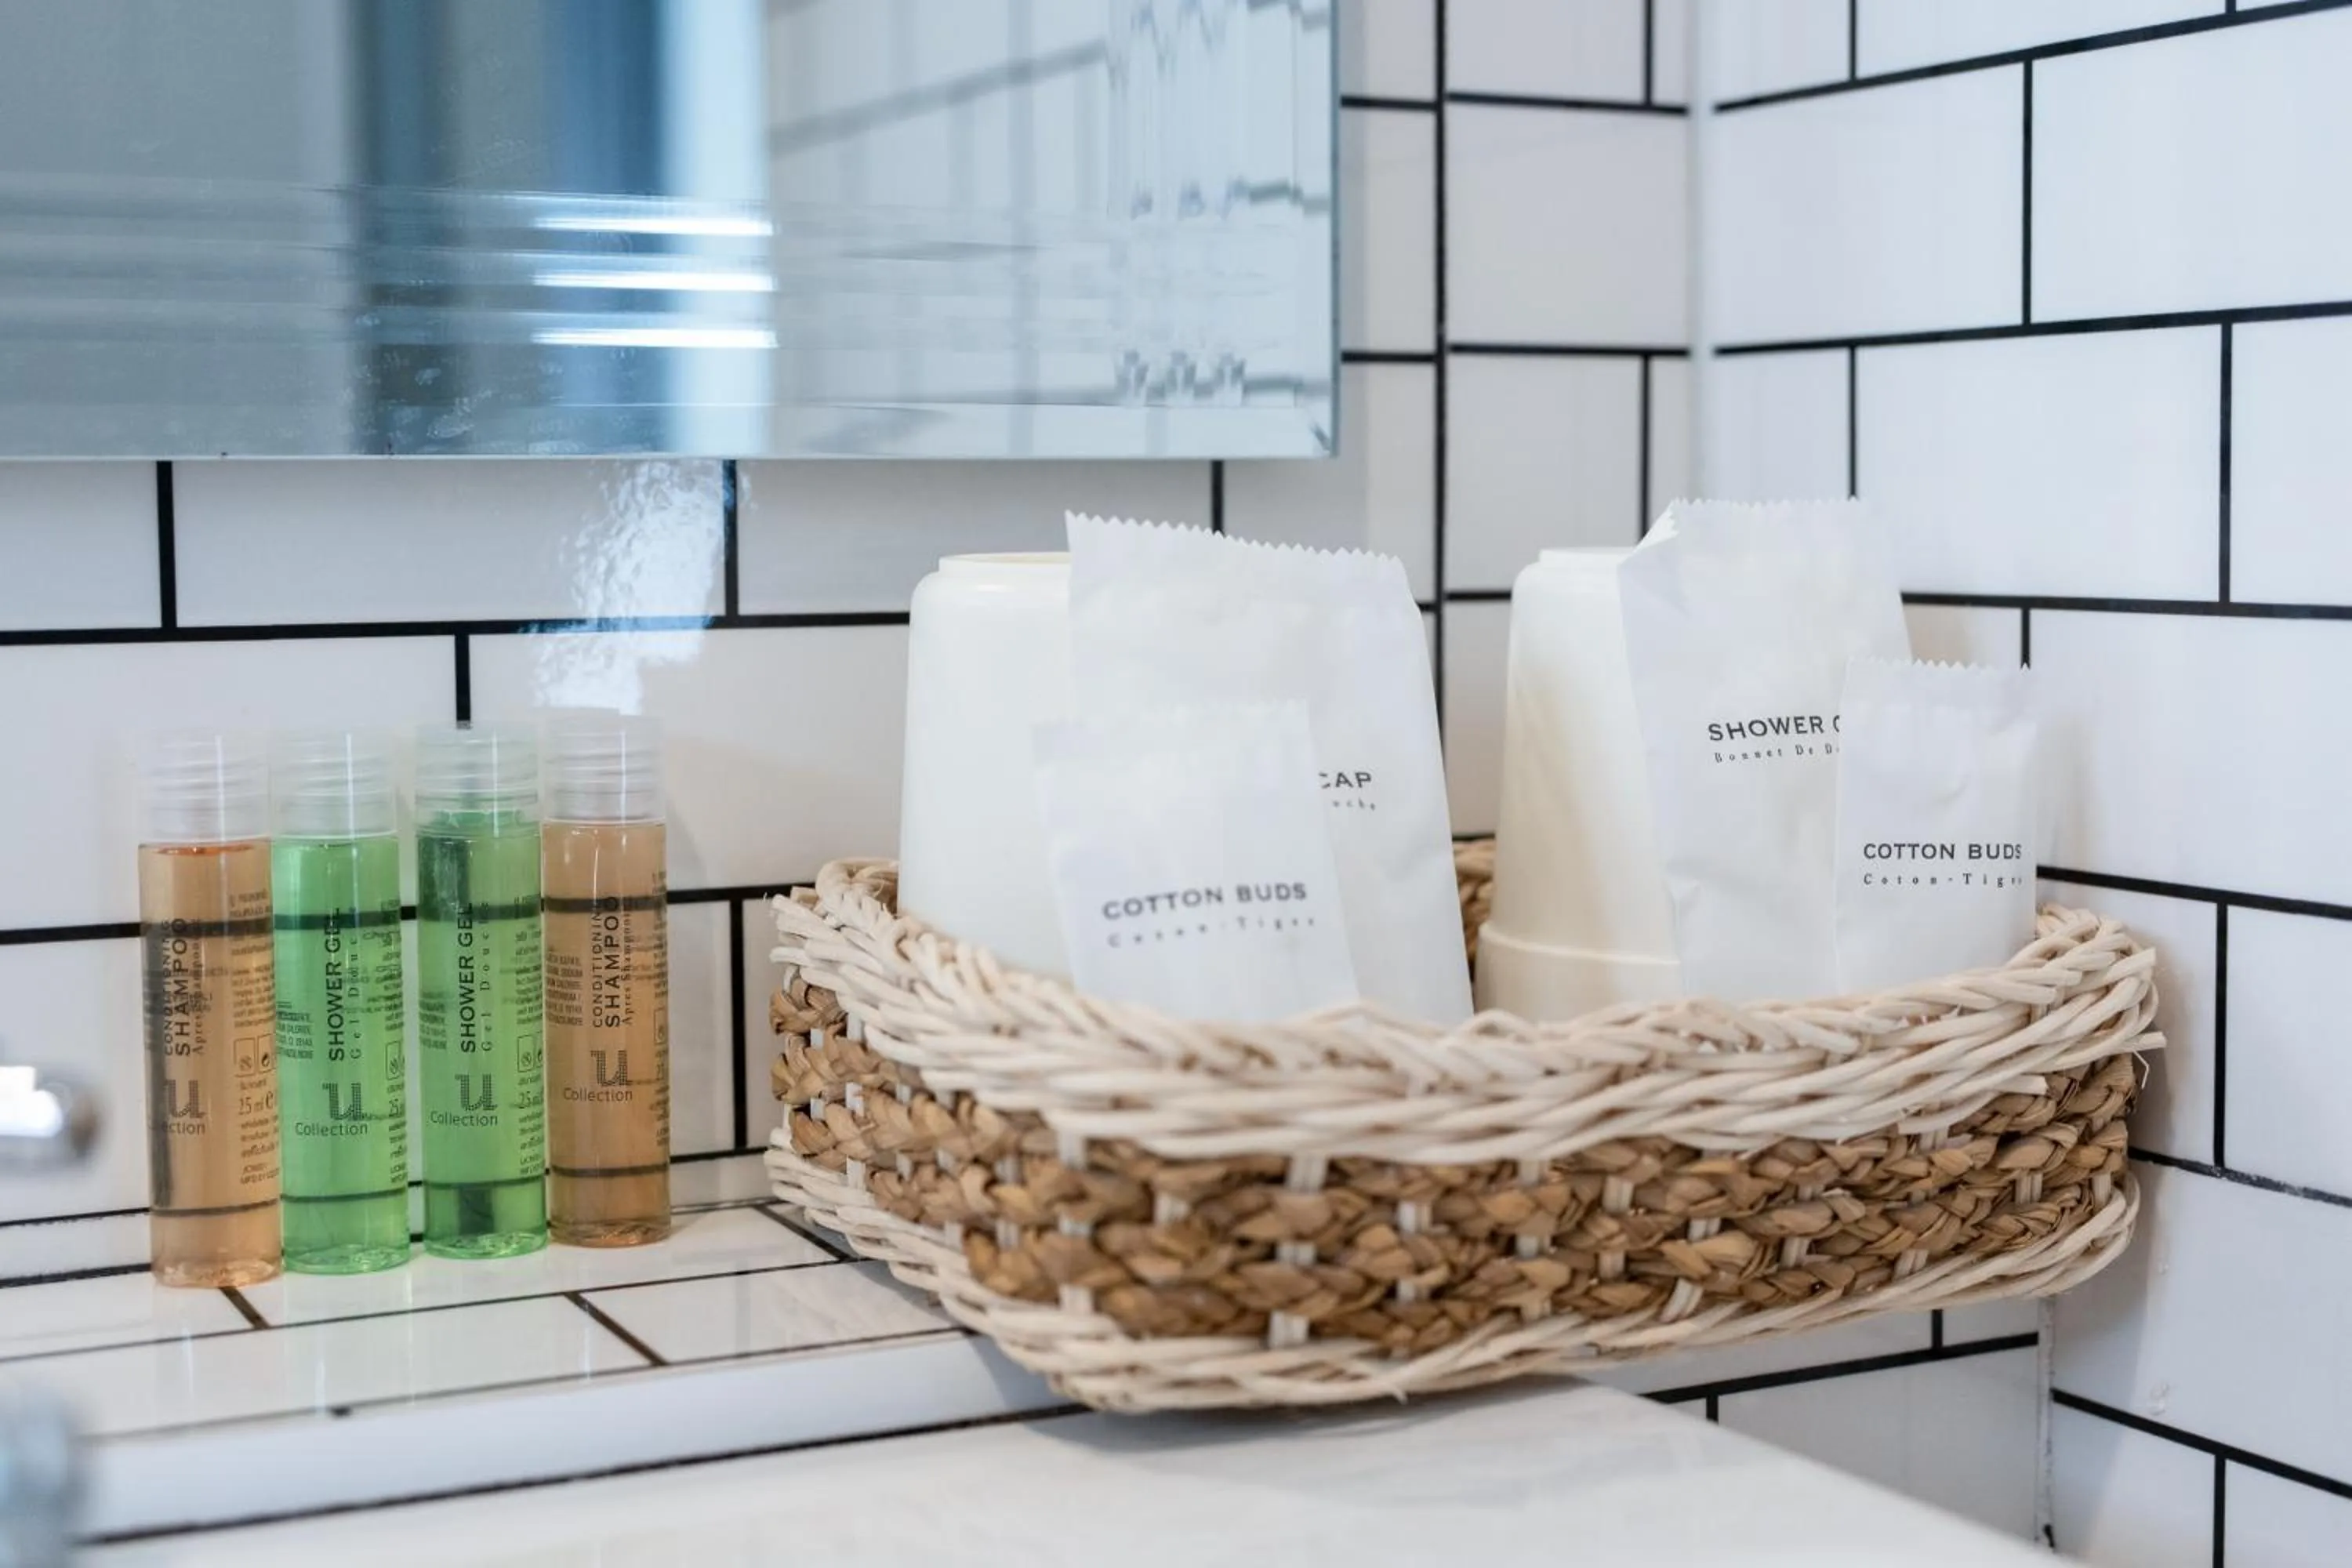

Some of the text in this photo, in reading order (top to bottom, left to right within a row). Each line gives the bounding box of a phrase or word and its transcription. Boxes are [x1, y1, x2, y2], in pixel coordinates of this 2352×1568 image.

[1708, 715, 1824, 742] SHOWER
[1714, 747, 1783, 764] Bonnet
[1795, 744, 1814, 756] De
[1863, 843, 2022, 860] COTTON BUDS
[1102, 882, 1308, 920] COTTON BUDS
[457, 902, 476, 1053] SHOWER GEL
[604, 895, 620, 1028] SHAMPOO
[171, 917, 191, 1057] SHAMPOO
[324, 907, 346, 1062] SHOWER GEL
[349, 1018, 362, 1060] Gel
[480, 1011, 493, 1051] Gel
[563, 1087, 633, 1102] Collection
[295, 1122, 368, 1136] Collection
[429, 1110, 499, 1127] Collection
